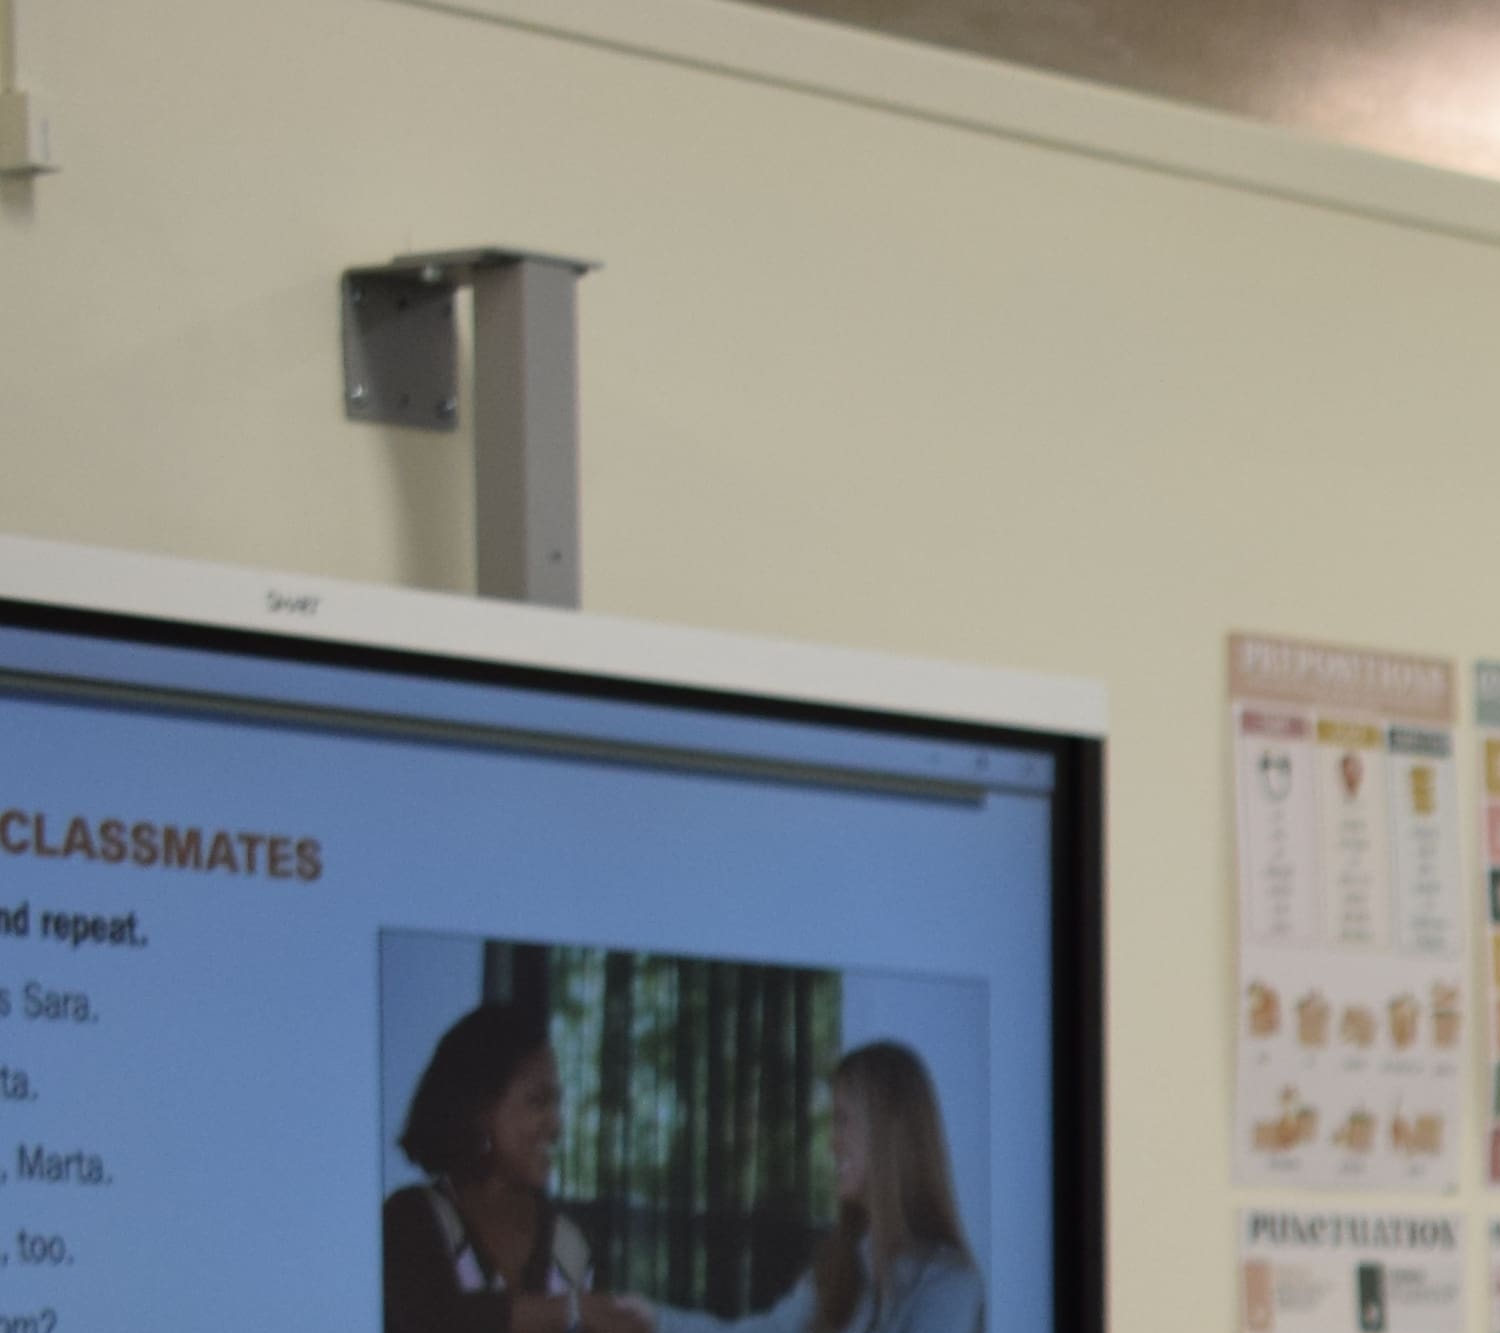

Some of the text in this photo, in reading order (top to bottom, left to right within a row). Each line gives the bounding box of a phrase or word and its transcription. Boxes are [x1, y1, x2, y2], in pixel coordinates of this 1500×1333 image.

[0, 808, 323, 882] CLASSMATES
[0, 901, 148, 949] nd repeat.
[23, 979, 98, 1023] Sara.
[17, 1144, 112, 1185] Marta.
[17, 1229, 75, 1265] too.
[1246, 1212, 1459, 1249] PUNCTUATION
